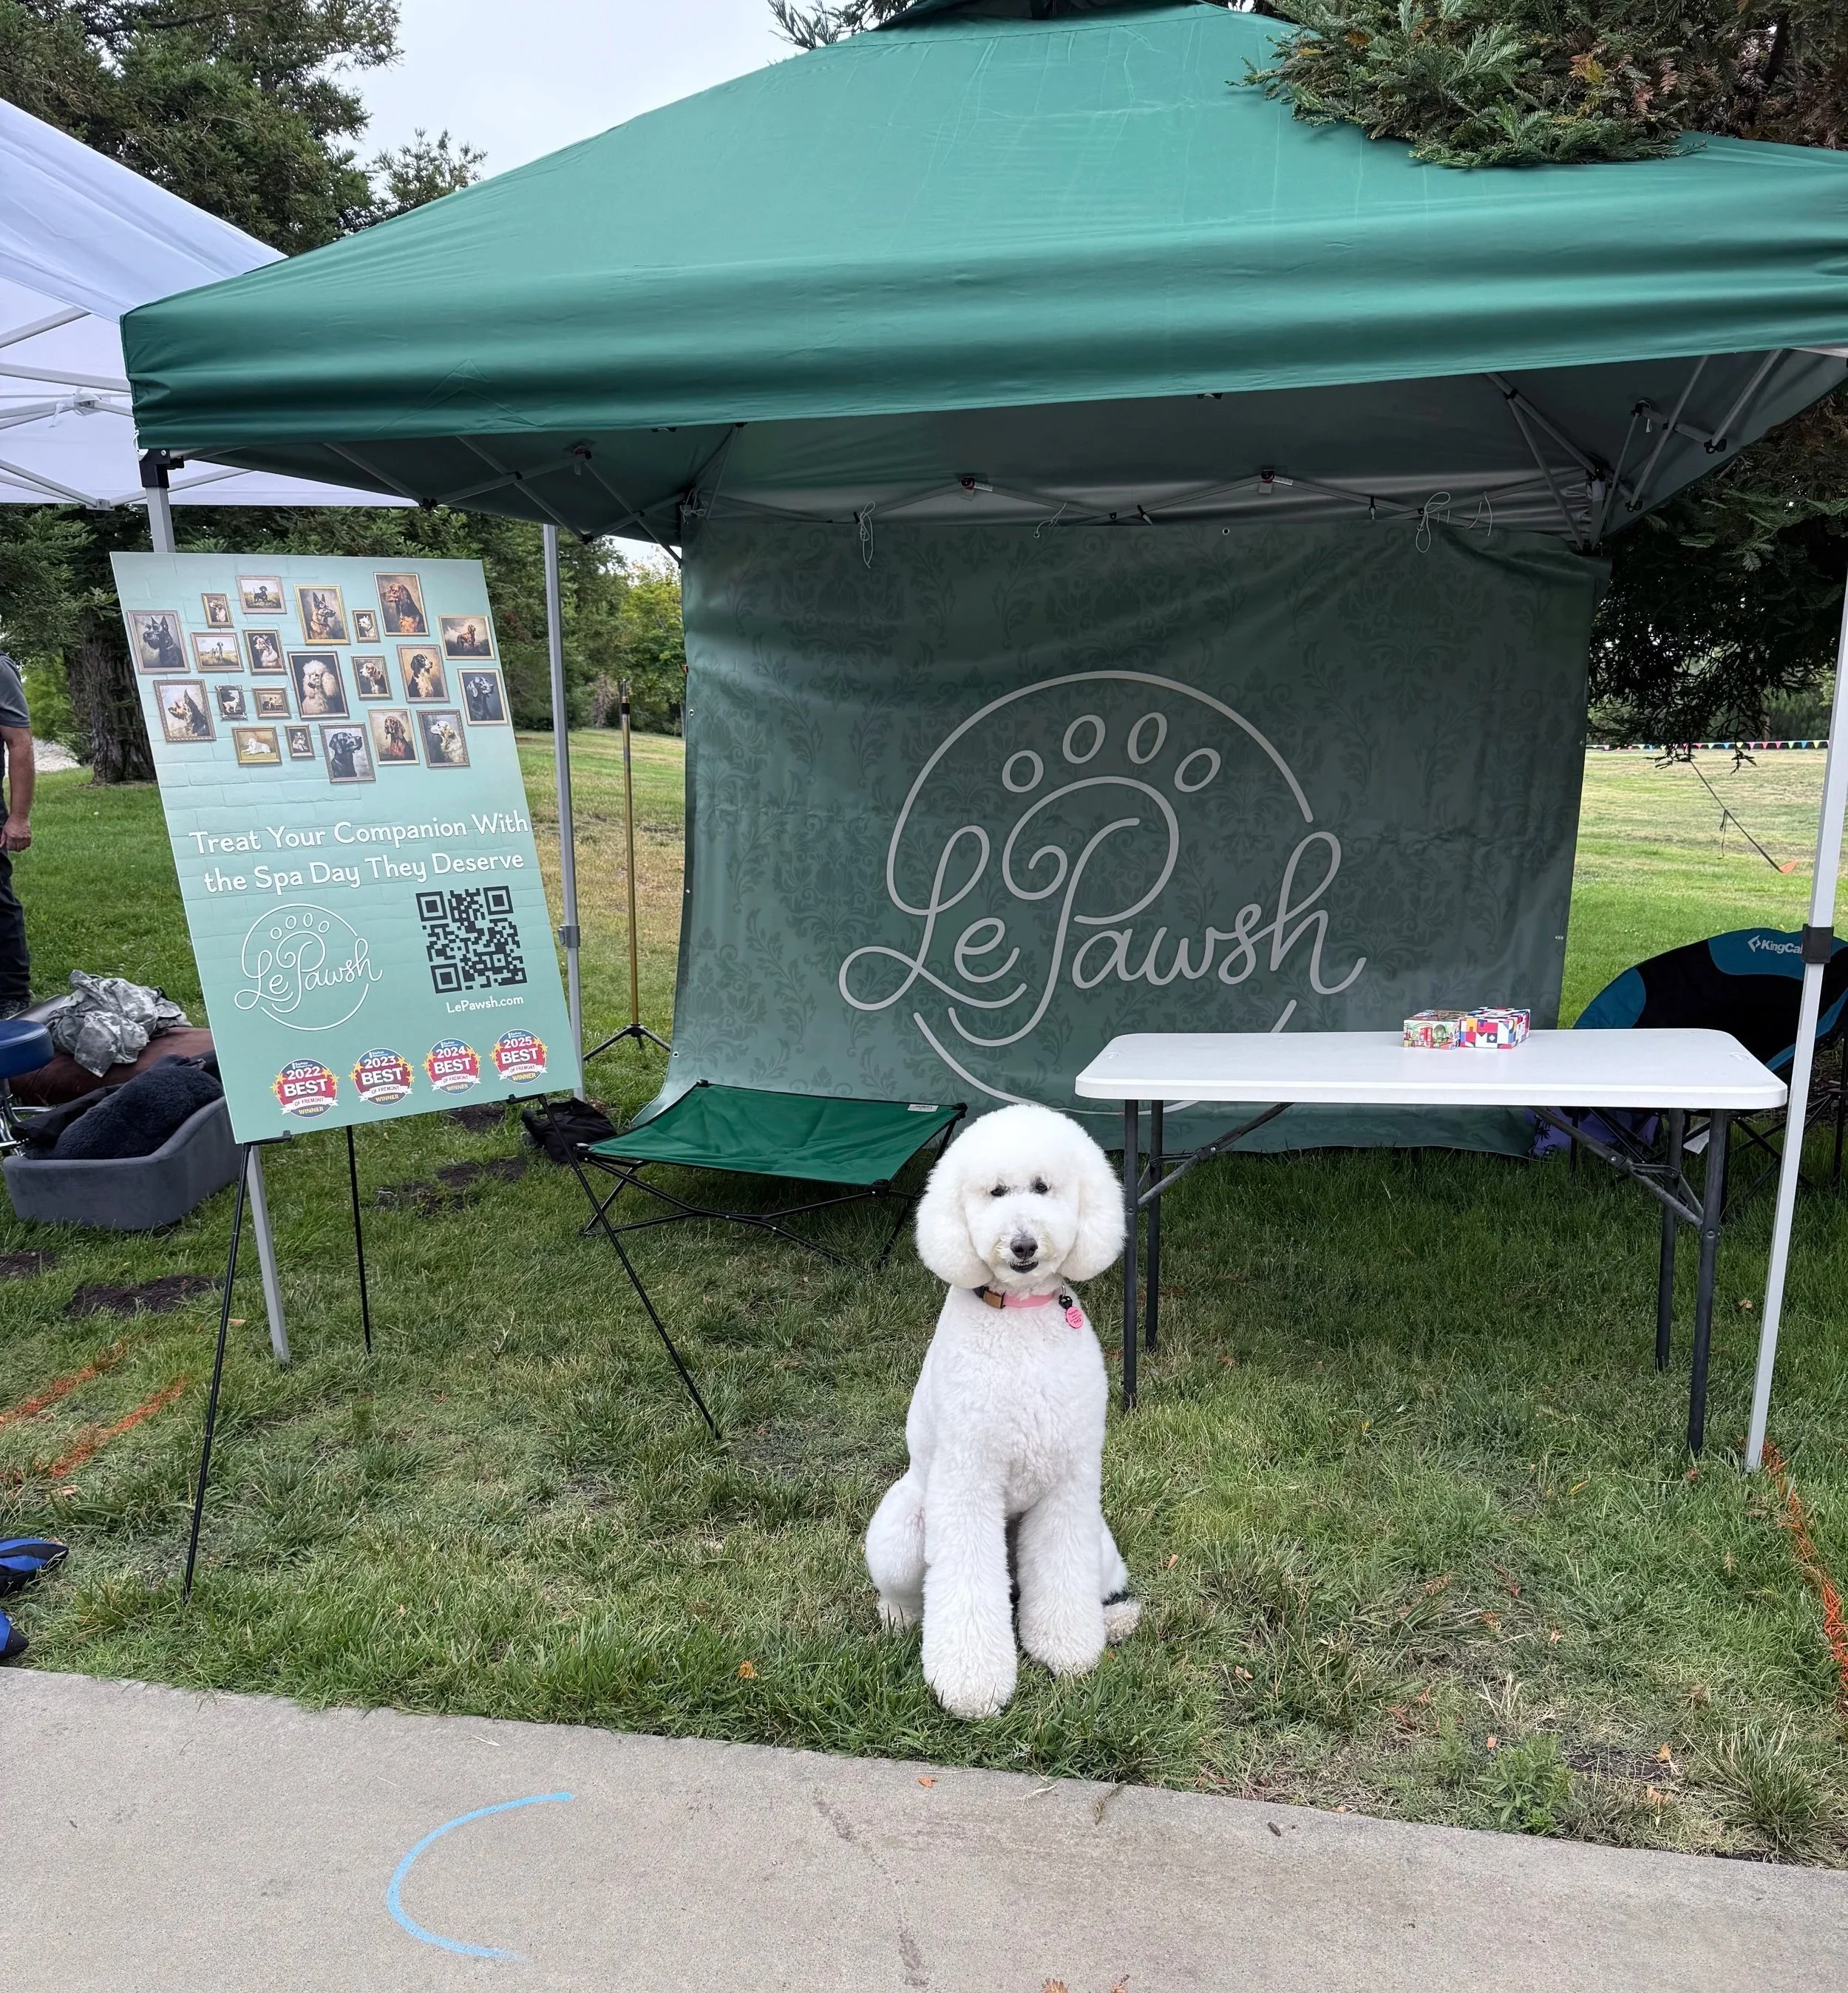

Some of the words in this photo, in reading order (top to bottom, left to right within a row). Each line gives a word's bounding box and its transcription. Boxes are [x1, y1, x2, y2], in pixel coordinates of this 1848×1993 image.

[188, 829, 262, 854] Treat
[266, 825, 325, 848] Your
[333, 817, 467, 849] Companion
[471, 810, 529, 835] With
[204, 868, 248, 893] the
[255, 865, 303, 895] Spa
[310, 862, 361, 888] Day
[364, 856, 427, 883] They
[431, 852, 524, 875] Deserve
[1760, 939, 1804, 954] KingCa
[446, 995, 524, 1014] LePawsh.com
[503, 1036, 533, 1049] 2025
[435, 1045, 466, 1059] 2024
[500, 1048, 539, 1065] BEST
[363, 1055, 397, 1069] 2023
[433, 1057, 472, 1074] BEST
[286, 1066, 322, 1081] 2022
[360, 1067, 404, 1085] BEST
[512, 1073, 537, 1081] WINNER
[283, 1079, 327, 1097] BEST
[375, 1094, 399, 1102] WINNER
[298, 1106, 324, 1115] WINNER
